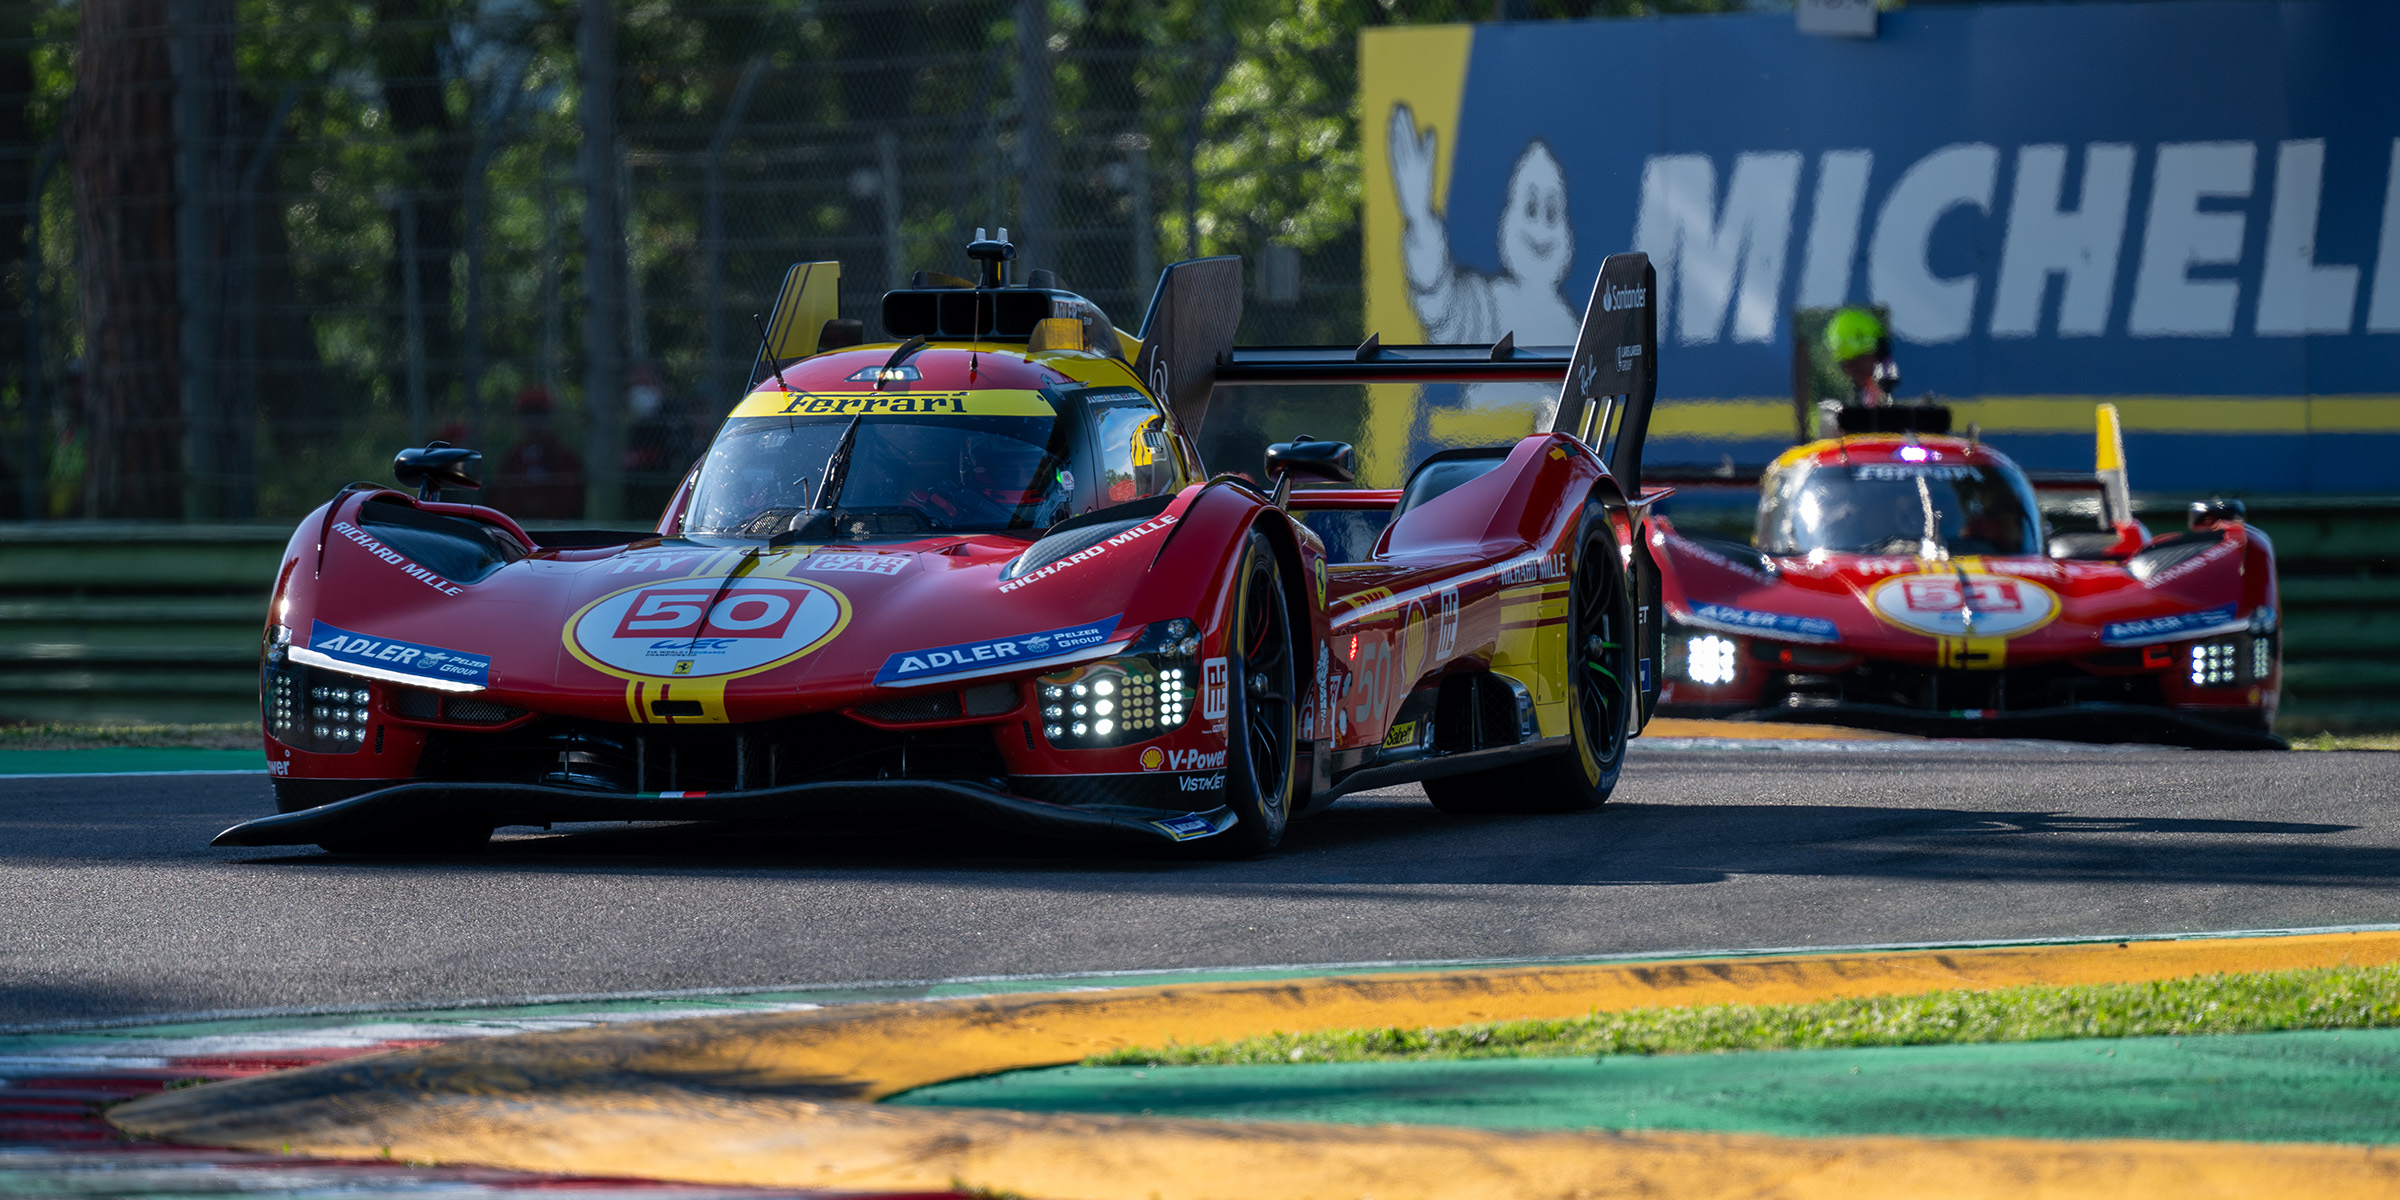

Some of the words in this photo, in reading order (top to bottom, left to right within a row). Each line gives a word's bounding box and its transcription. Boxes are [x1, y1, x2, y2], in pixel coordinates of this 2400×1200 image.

[1612, 283, 1646, 310] Santander
[778, 393, 967, 414] Ferrari
[331, 521, 404, 565] RICHARD
[401, 563, 463, 597] MILLE
[611, 556, 694, 574] HY
[822, 555, 904, 565] HYPER
[999, 546, 1105, 594] RICHARD
[1107, 514, 1179, 547] MILLE
[814, 561, 897, 573] CAR
[1501, 560, 1538, 585] RICHARD
[1539, 553, 1566, 579] MILLE
[1909, 583, 2015, 609] 51
[627, 594, 790, 631] 50
[1054, 628, 1100, 641] PELZER
[2111, 616, 2182, 638] ADLER
[315, 635, 421, 665] ADLER
[649, 638, 738, 649] WEC
[1058, 635, 1103, 648] GROUP
[449, 656, 488, 668] PELZER
[898, 642, 1020, 673] ADLER
[440, 664, 478, 677] GROUP
[1355, 640, 1392, 723] 50
[1387, 722, 1414, 746] Sabelt
[1168, 748, 1226, 770] V-Power
